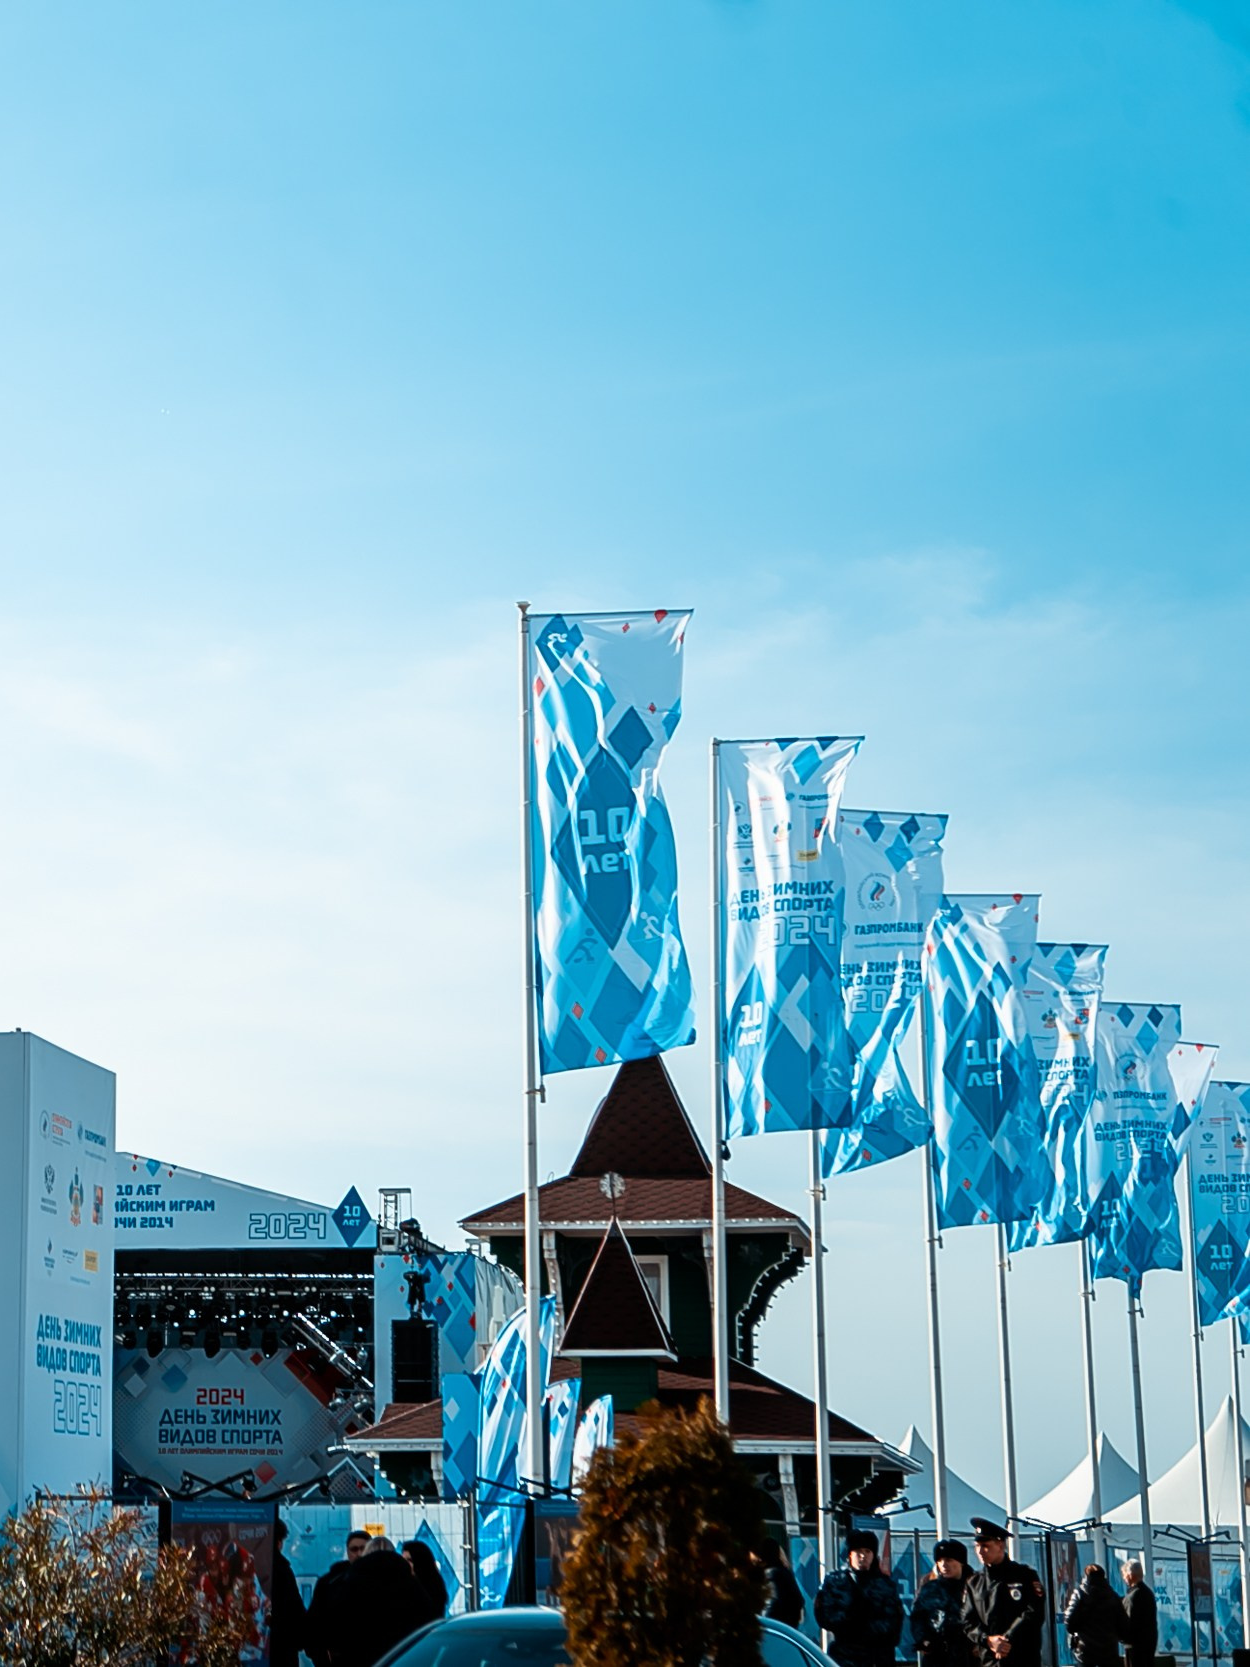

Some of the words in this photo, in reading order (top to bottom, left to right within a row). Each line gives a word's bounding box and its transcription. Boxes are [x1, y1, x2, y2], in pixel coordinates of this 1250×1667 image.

[580, 806, 630, 845] 10
[773, 896, 835, 912] СПОРТА
[854, 922, 924, 936] ГАЗПРОМБАНК
[740, 1000, 763, 1029] 10
[966, 1038, 1002, 1066] 10
[1198, 1173, 1229, 1184] ДЕНЬ
[115, 1184, 134, 1197] 10
[136, 1184, 162, 1197] ЛЕТ
[1199, 1183, 1237, 1194] ВИДОВ
[169, 1200, 215, 1212] ИГРАМ
[342, 1205, 361, 1218] 10
[139, 1216, 174, 1229] 2014
[249, 1212, 327, 1240] 2024
[341, 1218, 361, 1227] лет
[1209, 1245, 1233, 1259] 10
[36, 1313, 62, 1342] ДЕНЬ
[64, 1318, 102, 1349] ЗИМНИХ
[36, 1343, 68, 1374] ВИДОВ
[69, 1349, 102, 1377] СПОРТА
[196, 1387, 245, 1406] 2024
[53, 1379, 102, 1437] 2024
[158, 1408, 207, 1427] ДЕНЬ
[210, 1408, 282, 1426] ЗИМНИХ
[158, 1429, 217, 1447] ВИДОВ
[221, 1428, 283, 1445] СПОРТА
[158, 1447, 167, 1455] 10
